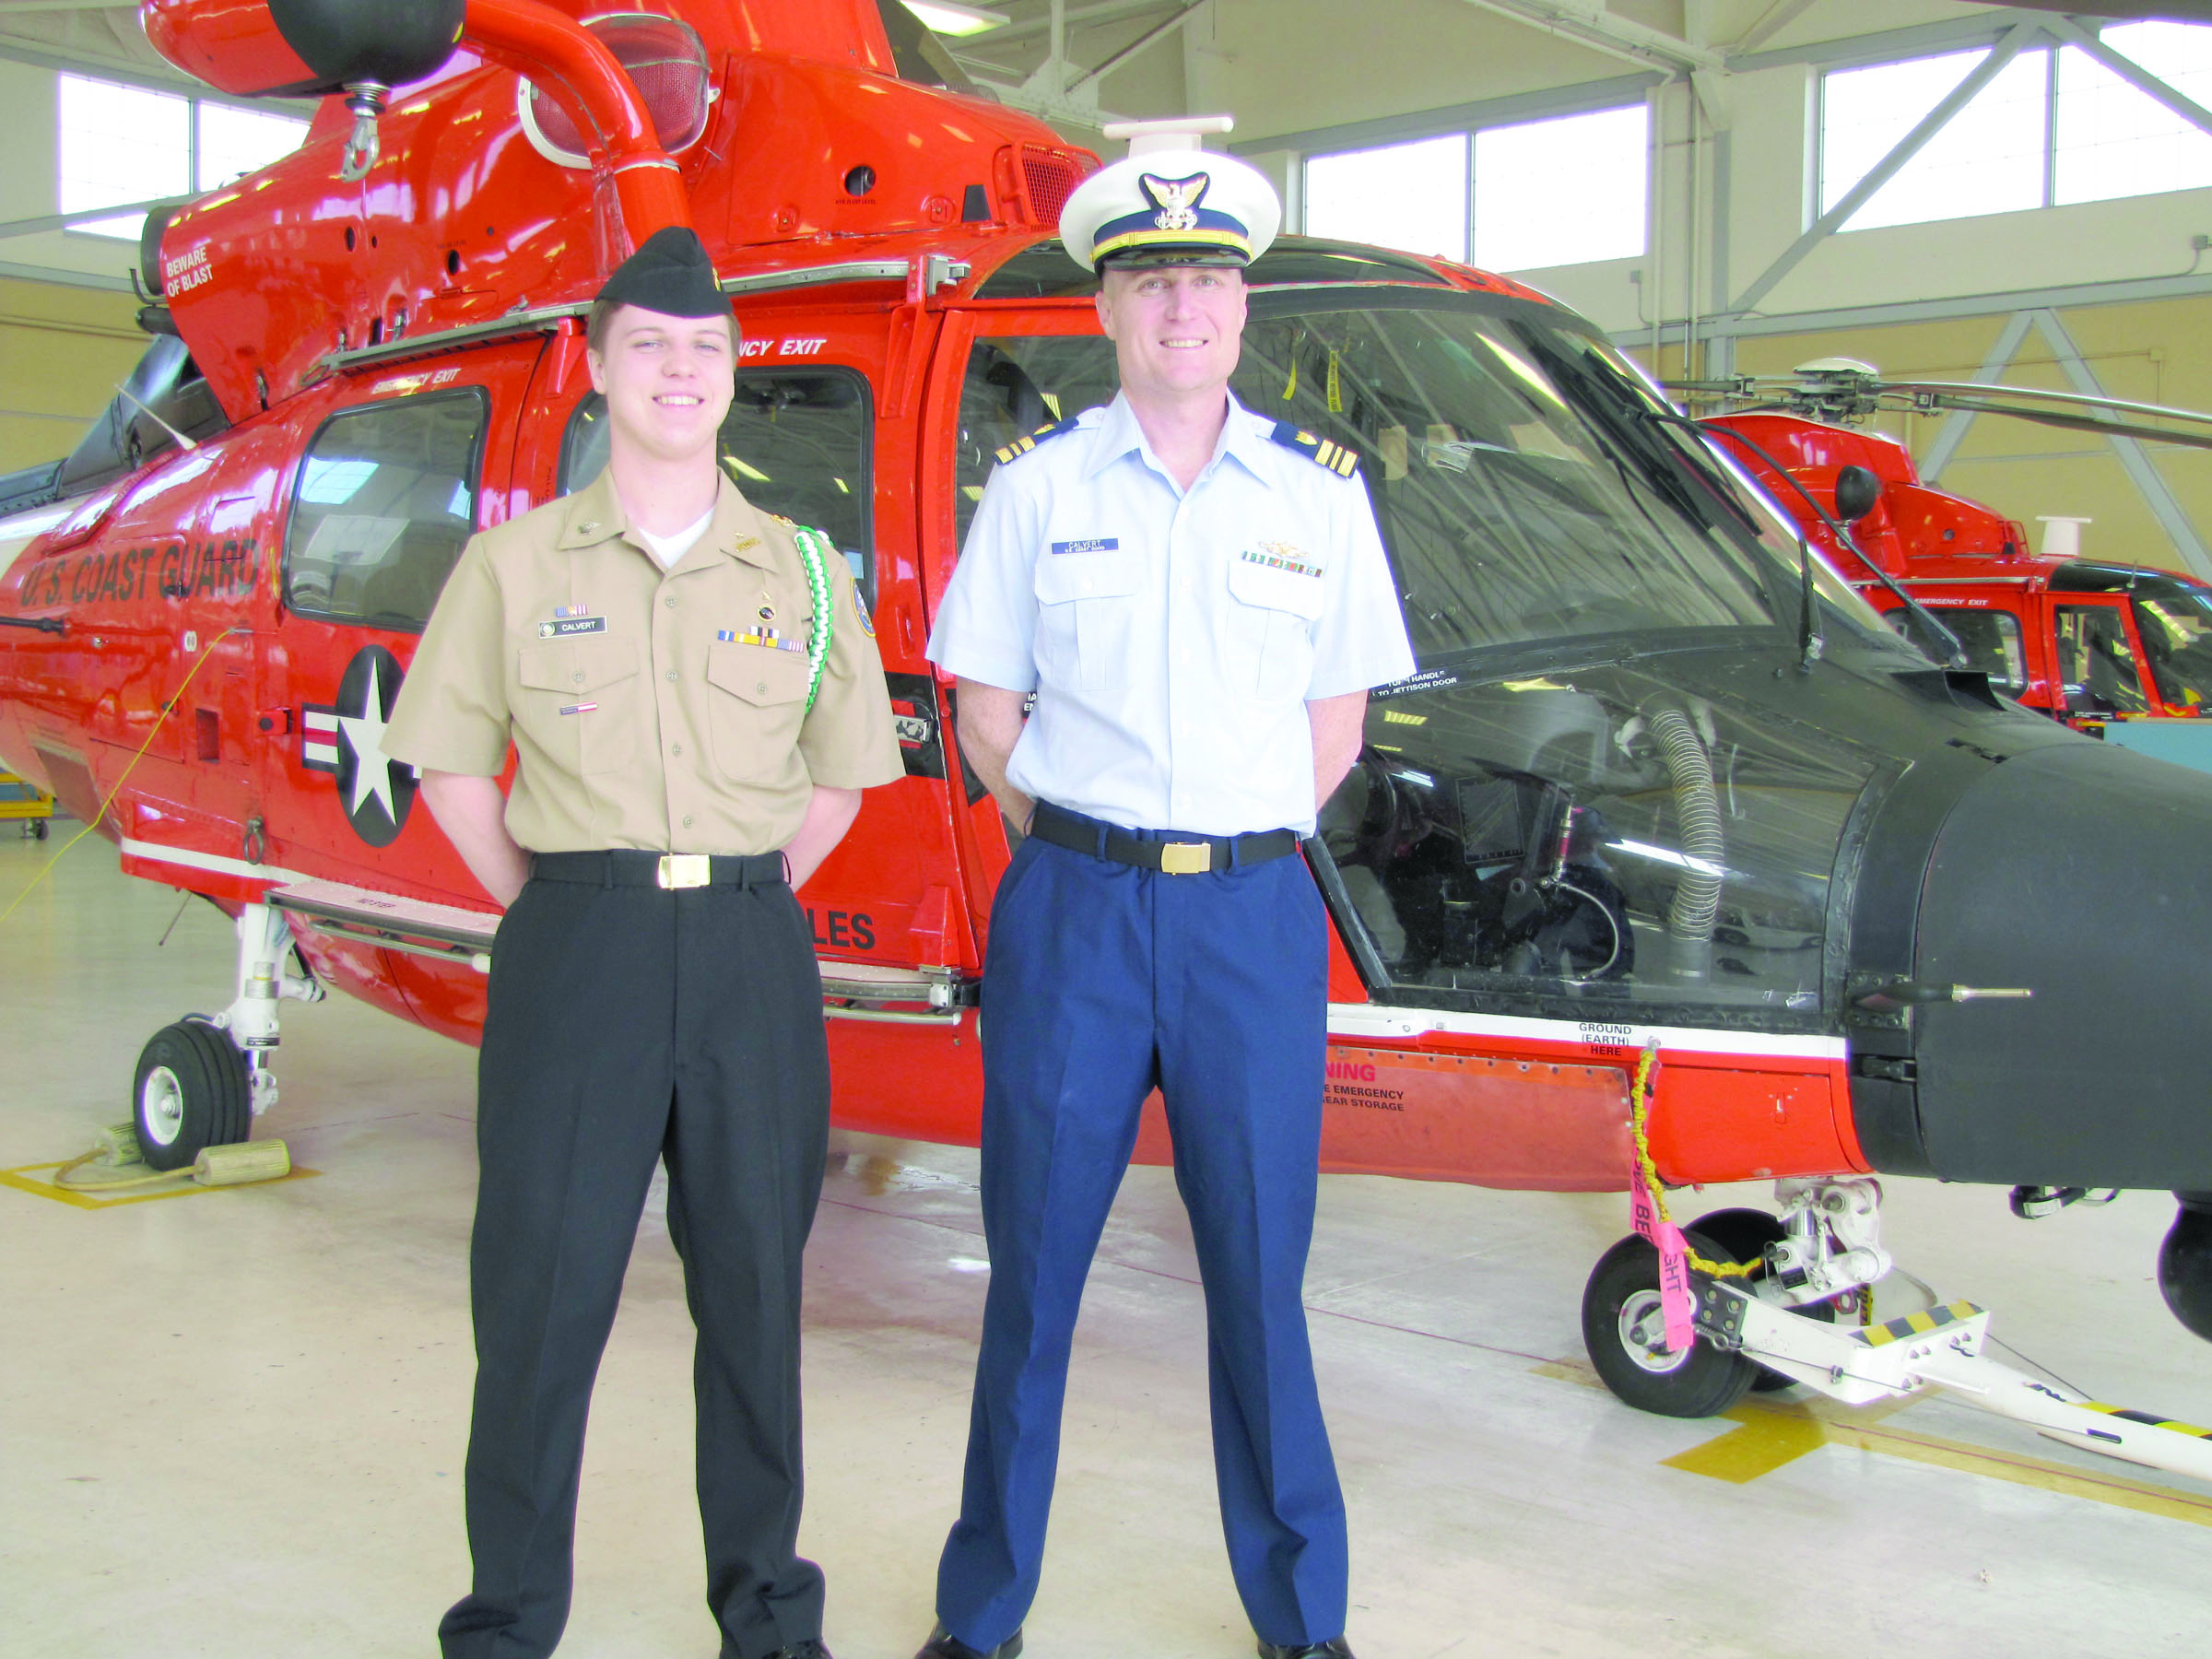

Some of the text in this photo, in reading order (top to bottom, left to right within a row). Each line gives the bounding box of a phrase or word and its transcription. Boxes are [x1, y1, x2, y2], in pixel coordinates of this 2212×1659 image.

[167, 246, 207, 278] BEWARE
[167, 264, 213, 298] OF BLAST
[779, 339, 827, 356] EXIT
[432, 368, 462, 384] EXIT
[1069, 540, 1100, 548] CALVERT
[71, 547, 156, 604] COAST
[158, 538, 259, 598] GUARD
[561, 621, 595, 631] CALVERT
[1431, 677, 1458, 688] DOOR
[806, 908, 876, 950] LES
[1579, 1022, 1632, 1034] GROUND
[1582, 1033, 1630, 1047] (EARTH)
[1591, 1045, 1622, 1056] HERE
[1325, 1062, 1376, 1082] NING
[1333, 1085, 1405, 1100] EMERGENCY
[1323, 1096, 1406, 1112] EAR STORAGE
